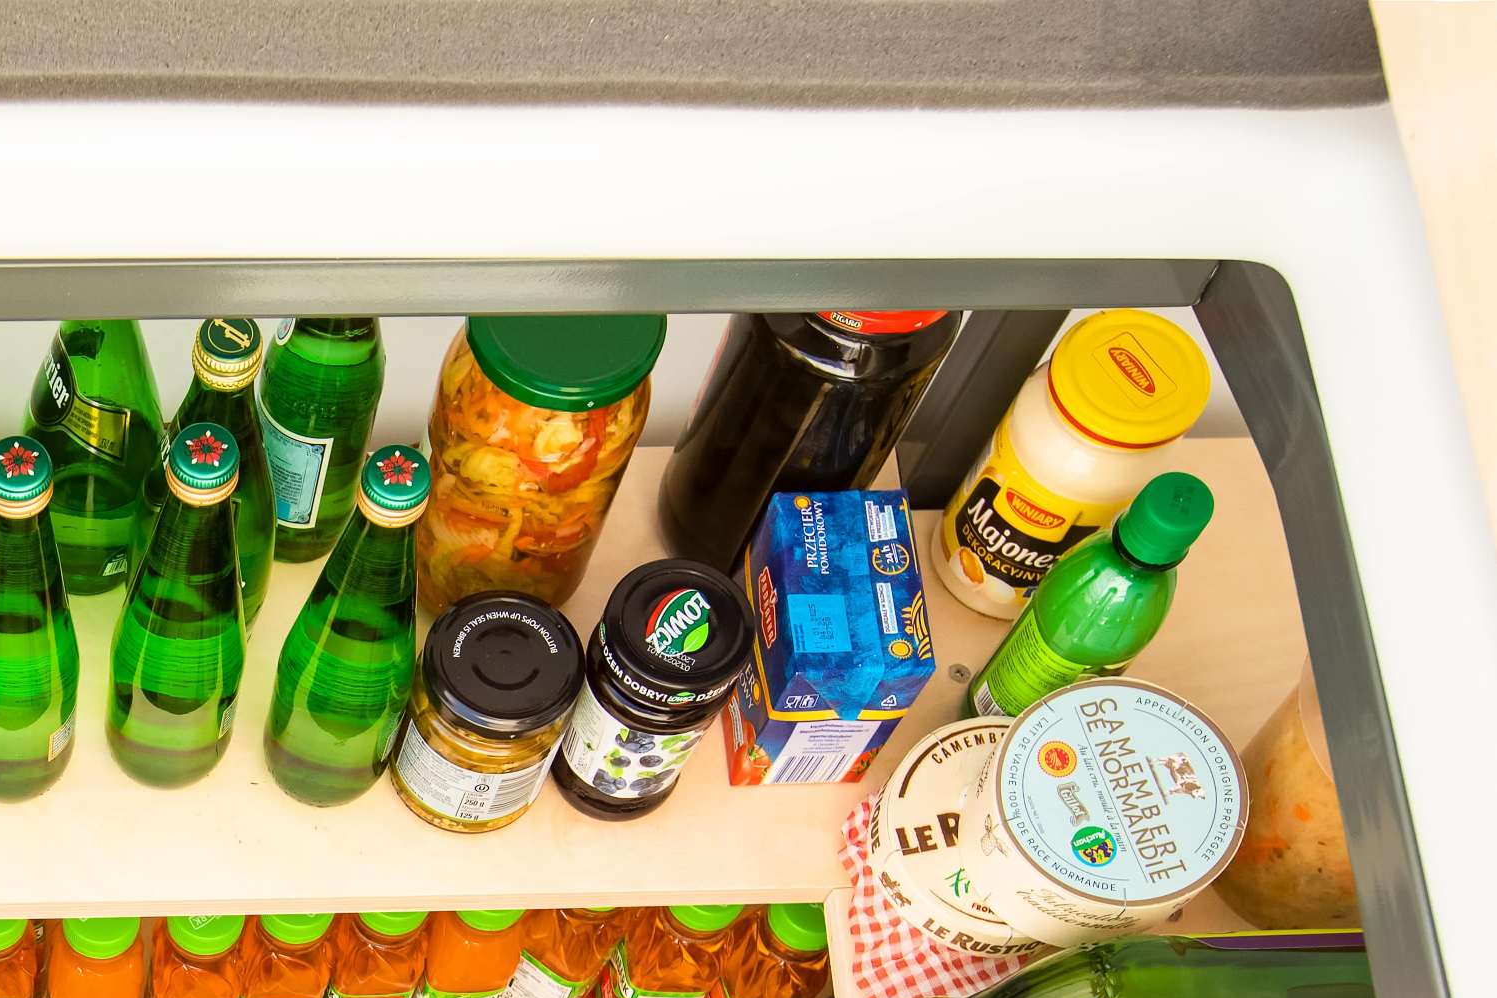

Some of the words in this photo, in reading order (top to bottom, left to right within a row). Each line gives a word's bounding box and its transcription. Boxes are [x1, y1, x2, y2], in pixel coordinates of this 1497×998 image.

[833, 313, 861, 327] FIGARO
[1112, 351, 1150, 388] WINIARY
[1012, 496, 1064, 526] WINIARY
[802, 506, 818, 569] PRZECIER
[813, 500, 830, 575] POMIDOROWY
[463, 625, 471, 633] IS
[467, 614, 486, 629] SEAL
[486, 611, 509, 620] WHEN
[510, 612, 521, 620] UP
[521, 615, 541, 630] POPS
[646, 592, 711, 652] ŁOWICZ
[453, 631, 466, 658] BROKEN
[539, 627, 558, 654] BUTTON
[603, 647, 627, 678] DŻEM
[624, 676, 668, 703] DOBRY!
[1031, 716, 1049, 737] LAIT
[932, 732, 1004, 764] CAMEMB
[1020, 736, 1031, 751] DE
[1135, 696, 1210, 744] APPELLATION
[1208, 745, 1233, 803] D'ORIGINE
[1009, 754, 1023, 786] VACHE
[1080, 700, 1101, 734] DE
[1095, 740, 1171, 884] NORMANDIE
[1099, 698, 1188, 873] CAMEMBERT
[464, 799, 477, 807] 250
[1008, 790, 1023, 819] 100%
[896, 825, 938, 857] LE
[1017, 822, 1029, 837] DE
[1073, 831, 1106, 848] Auchan
[1027, 837, 1049, 863] RACE
[1051, 861, 1117, 892] NORMANDE
[922, 917, 950, 939] LE
